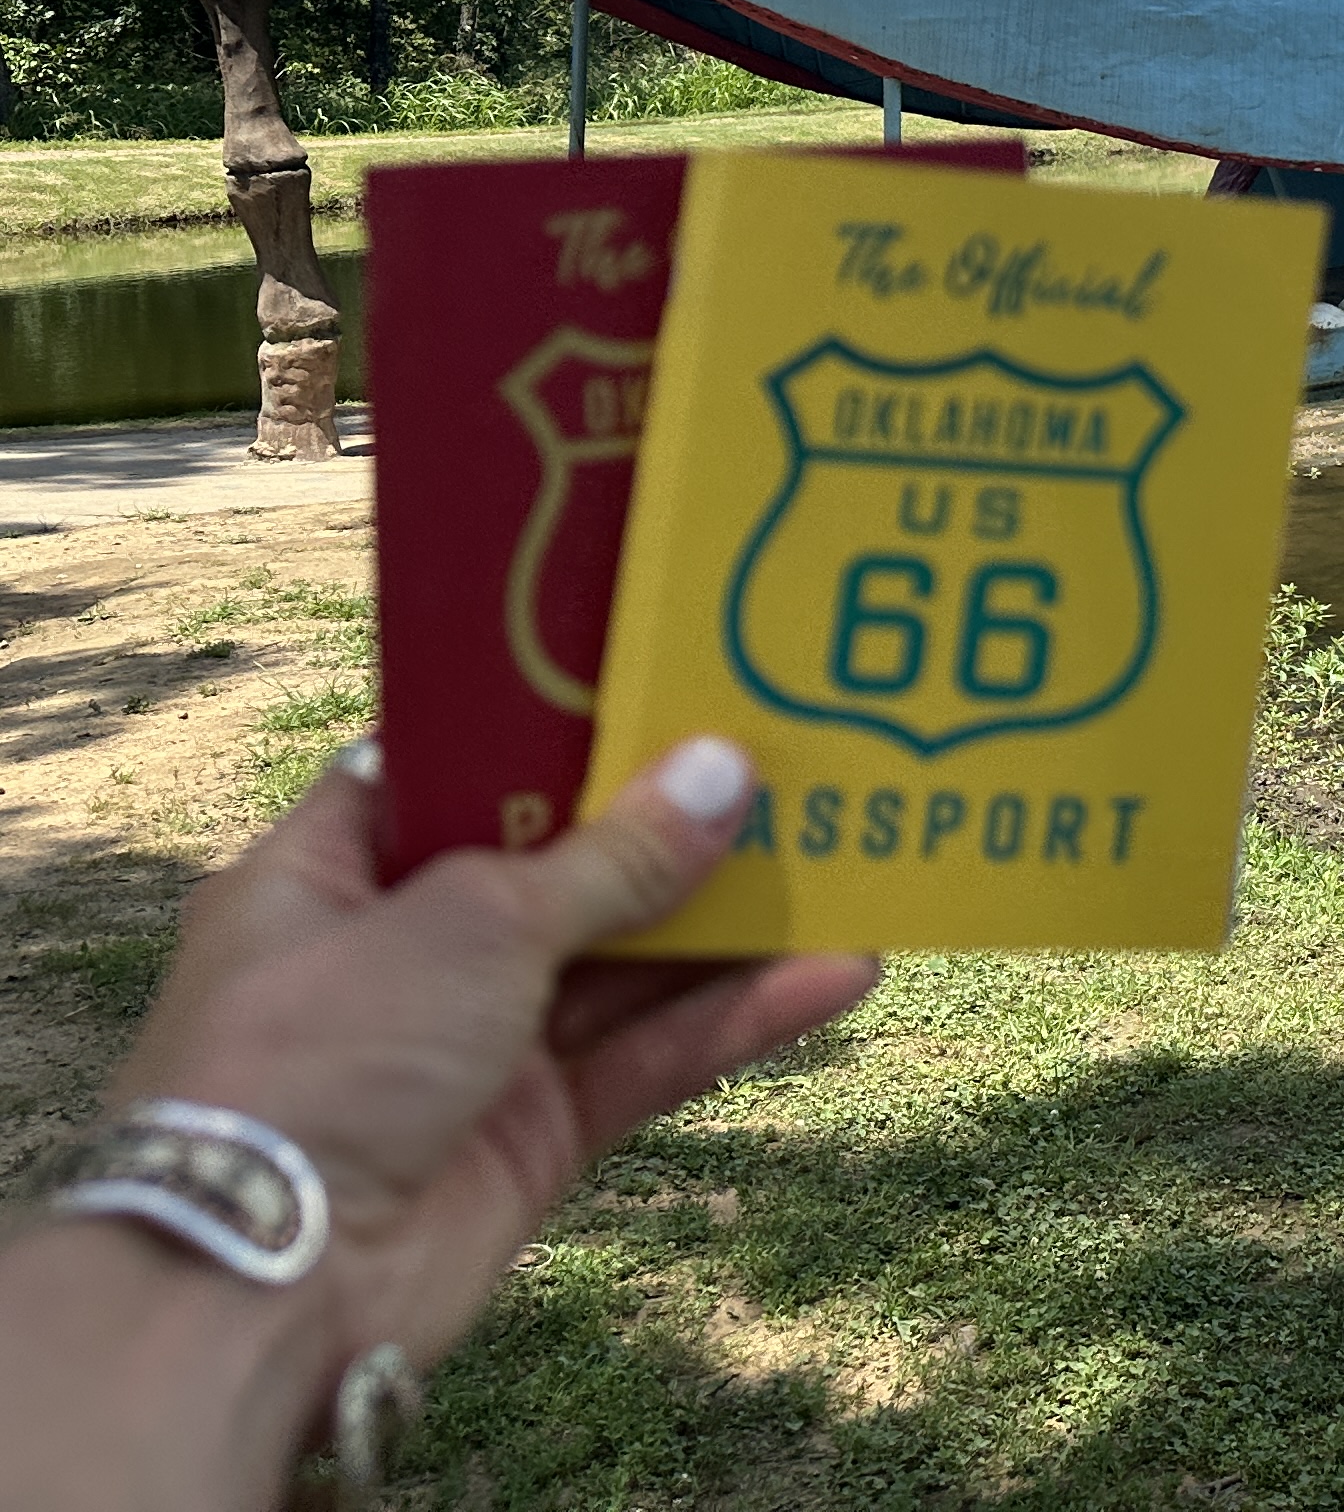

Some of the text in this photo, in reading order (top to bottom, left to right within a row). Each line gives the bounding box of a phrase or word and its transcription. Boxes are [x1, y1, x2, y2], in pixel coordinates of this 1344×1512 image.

[543, 207, 658, 290] The
[836, 220, 1170, 319] The Official
[833, 388, 1111, 456] OKLAHOMA
[899, 482, 1022, 540] US
[828, 554, 1060, 700] 66
[732, 783, 1145, 865] ASSPORT
